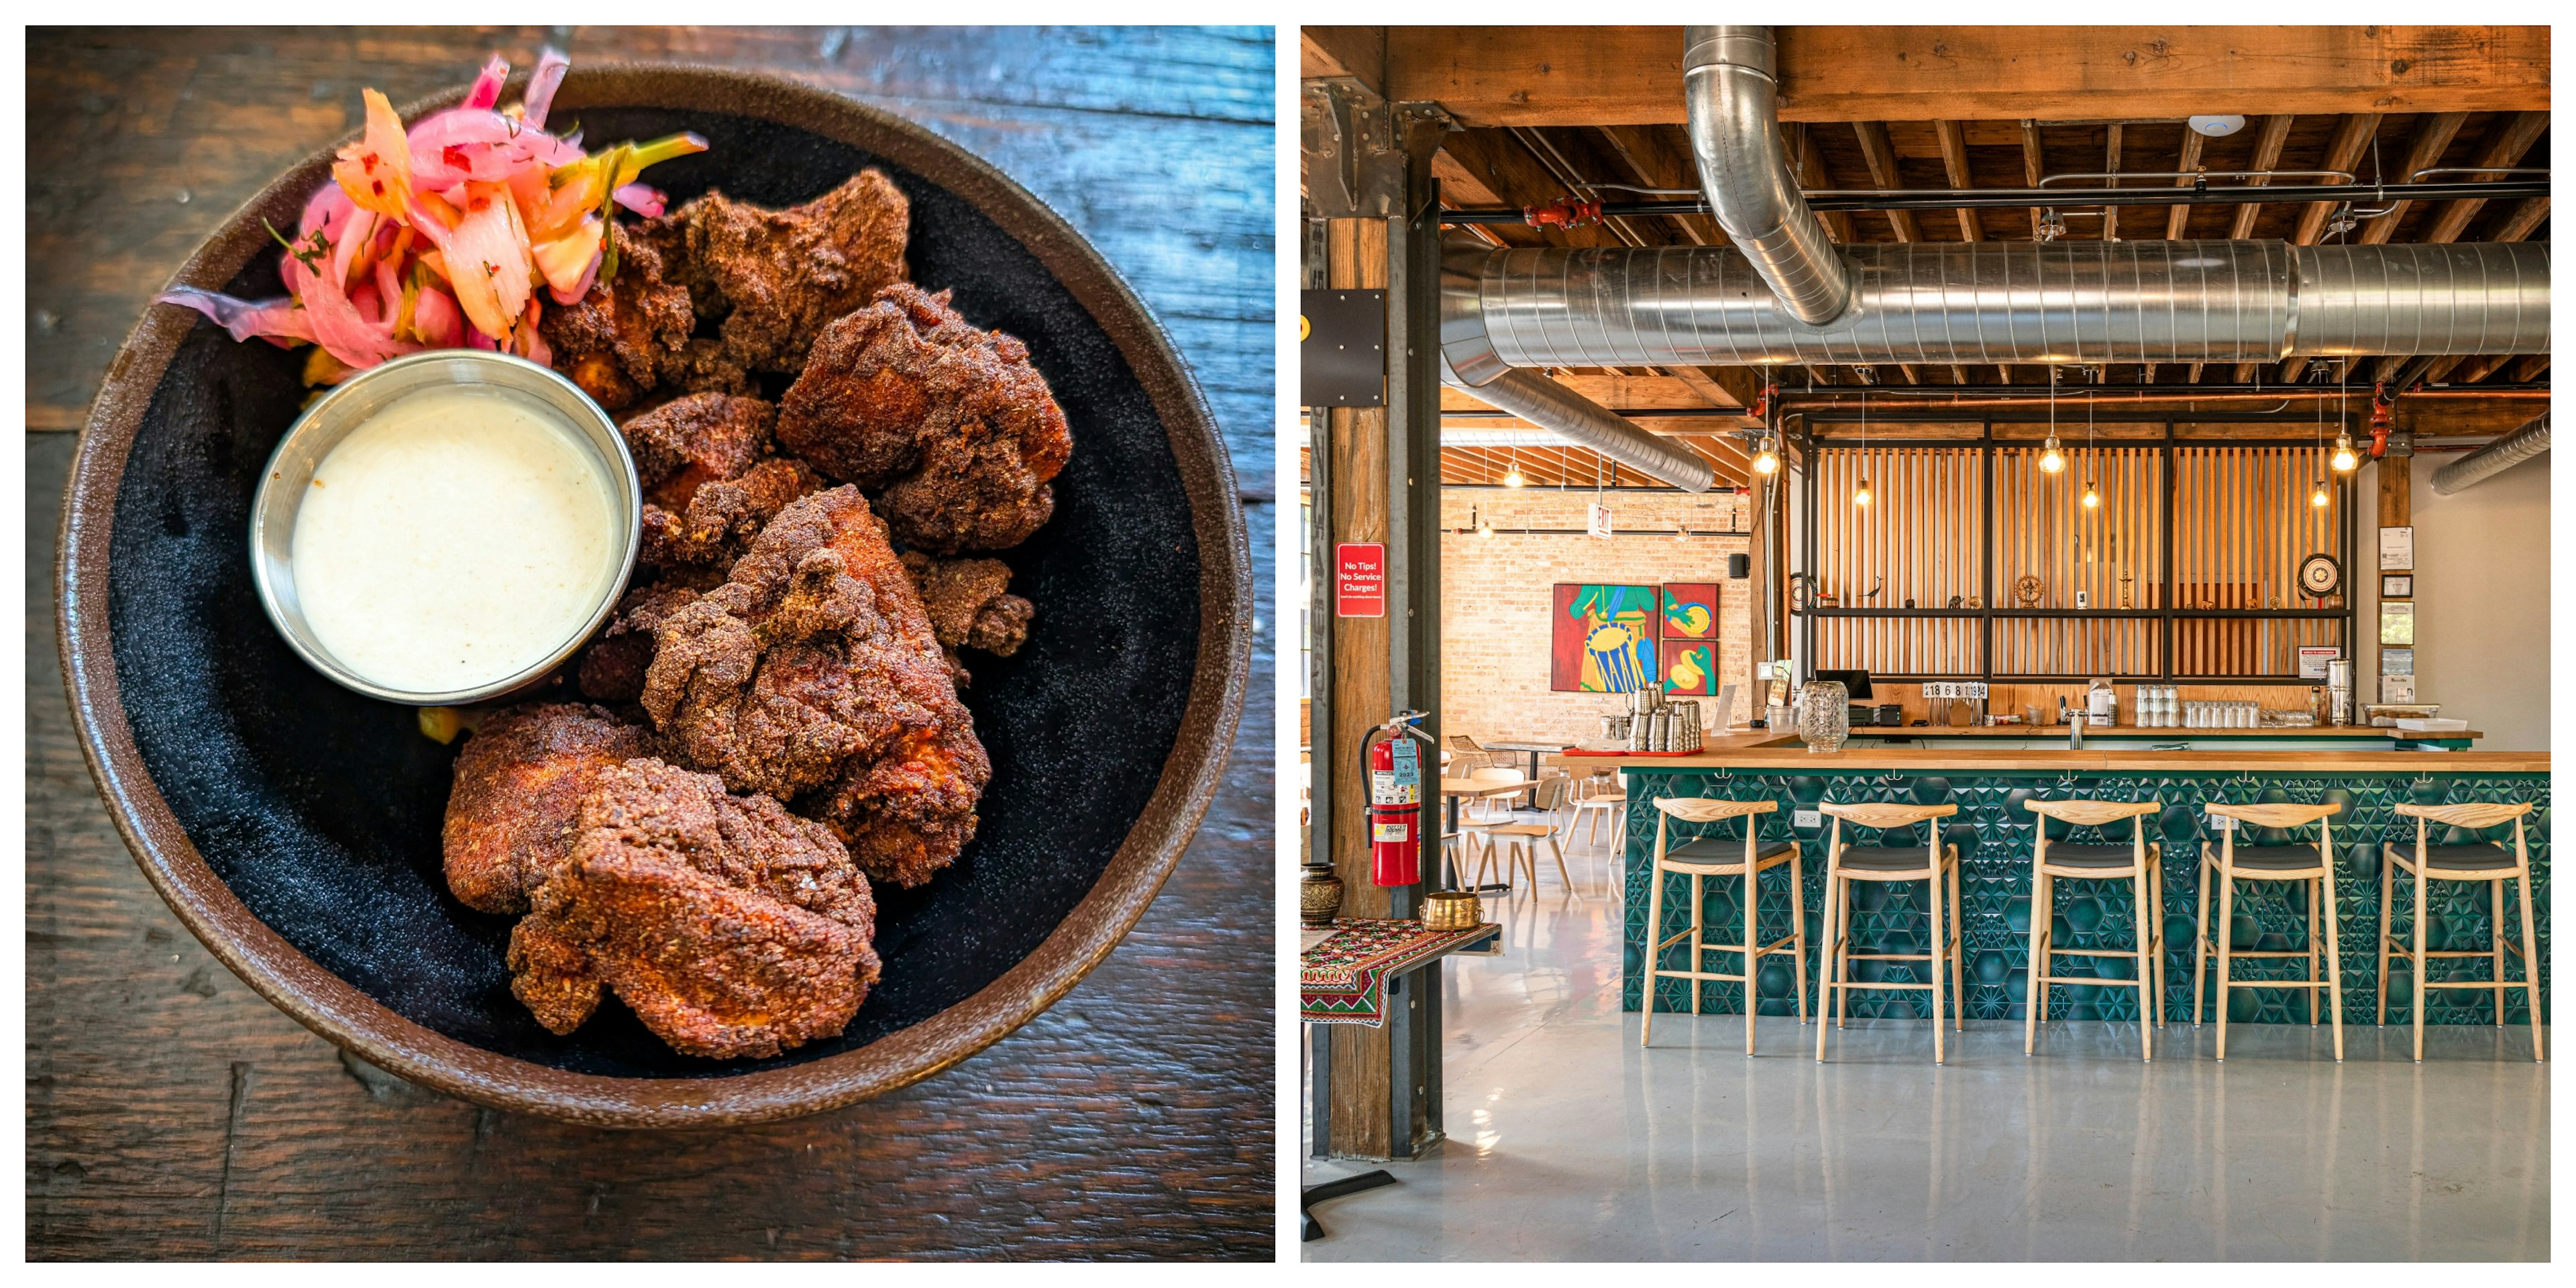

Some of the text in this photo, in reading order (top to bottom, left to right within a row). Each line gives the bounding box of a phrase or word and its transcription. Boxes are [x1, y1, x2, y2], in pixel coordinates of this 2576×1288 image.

[1598, 507, 1609, 530] EXIT
[1358, 562, 1376, 571] Tips!
[1344, 584, 1377, 592] Charges!
[1929, 685, 1940, 696] 18
[1945, 685, 1951, 696] 6
[1955, 686, 1961, 696] 8
